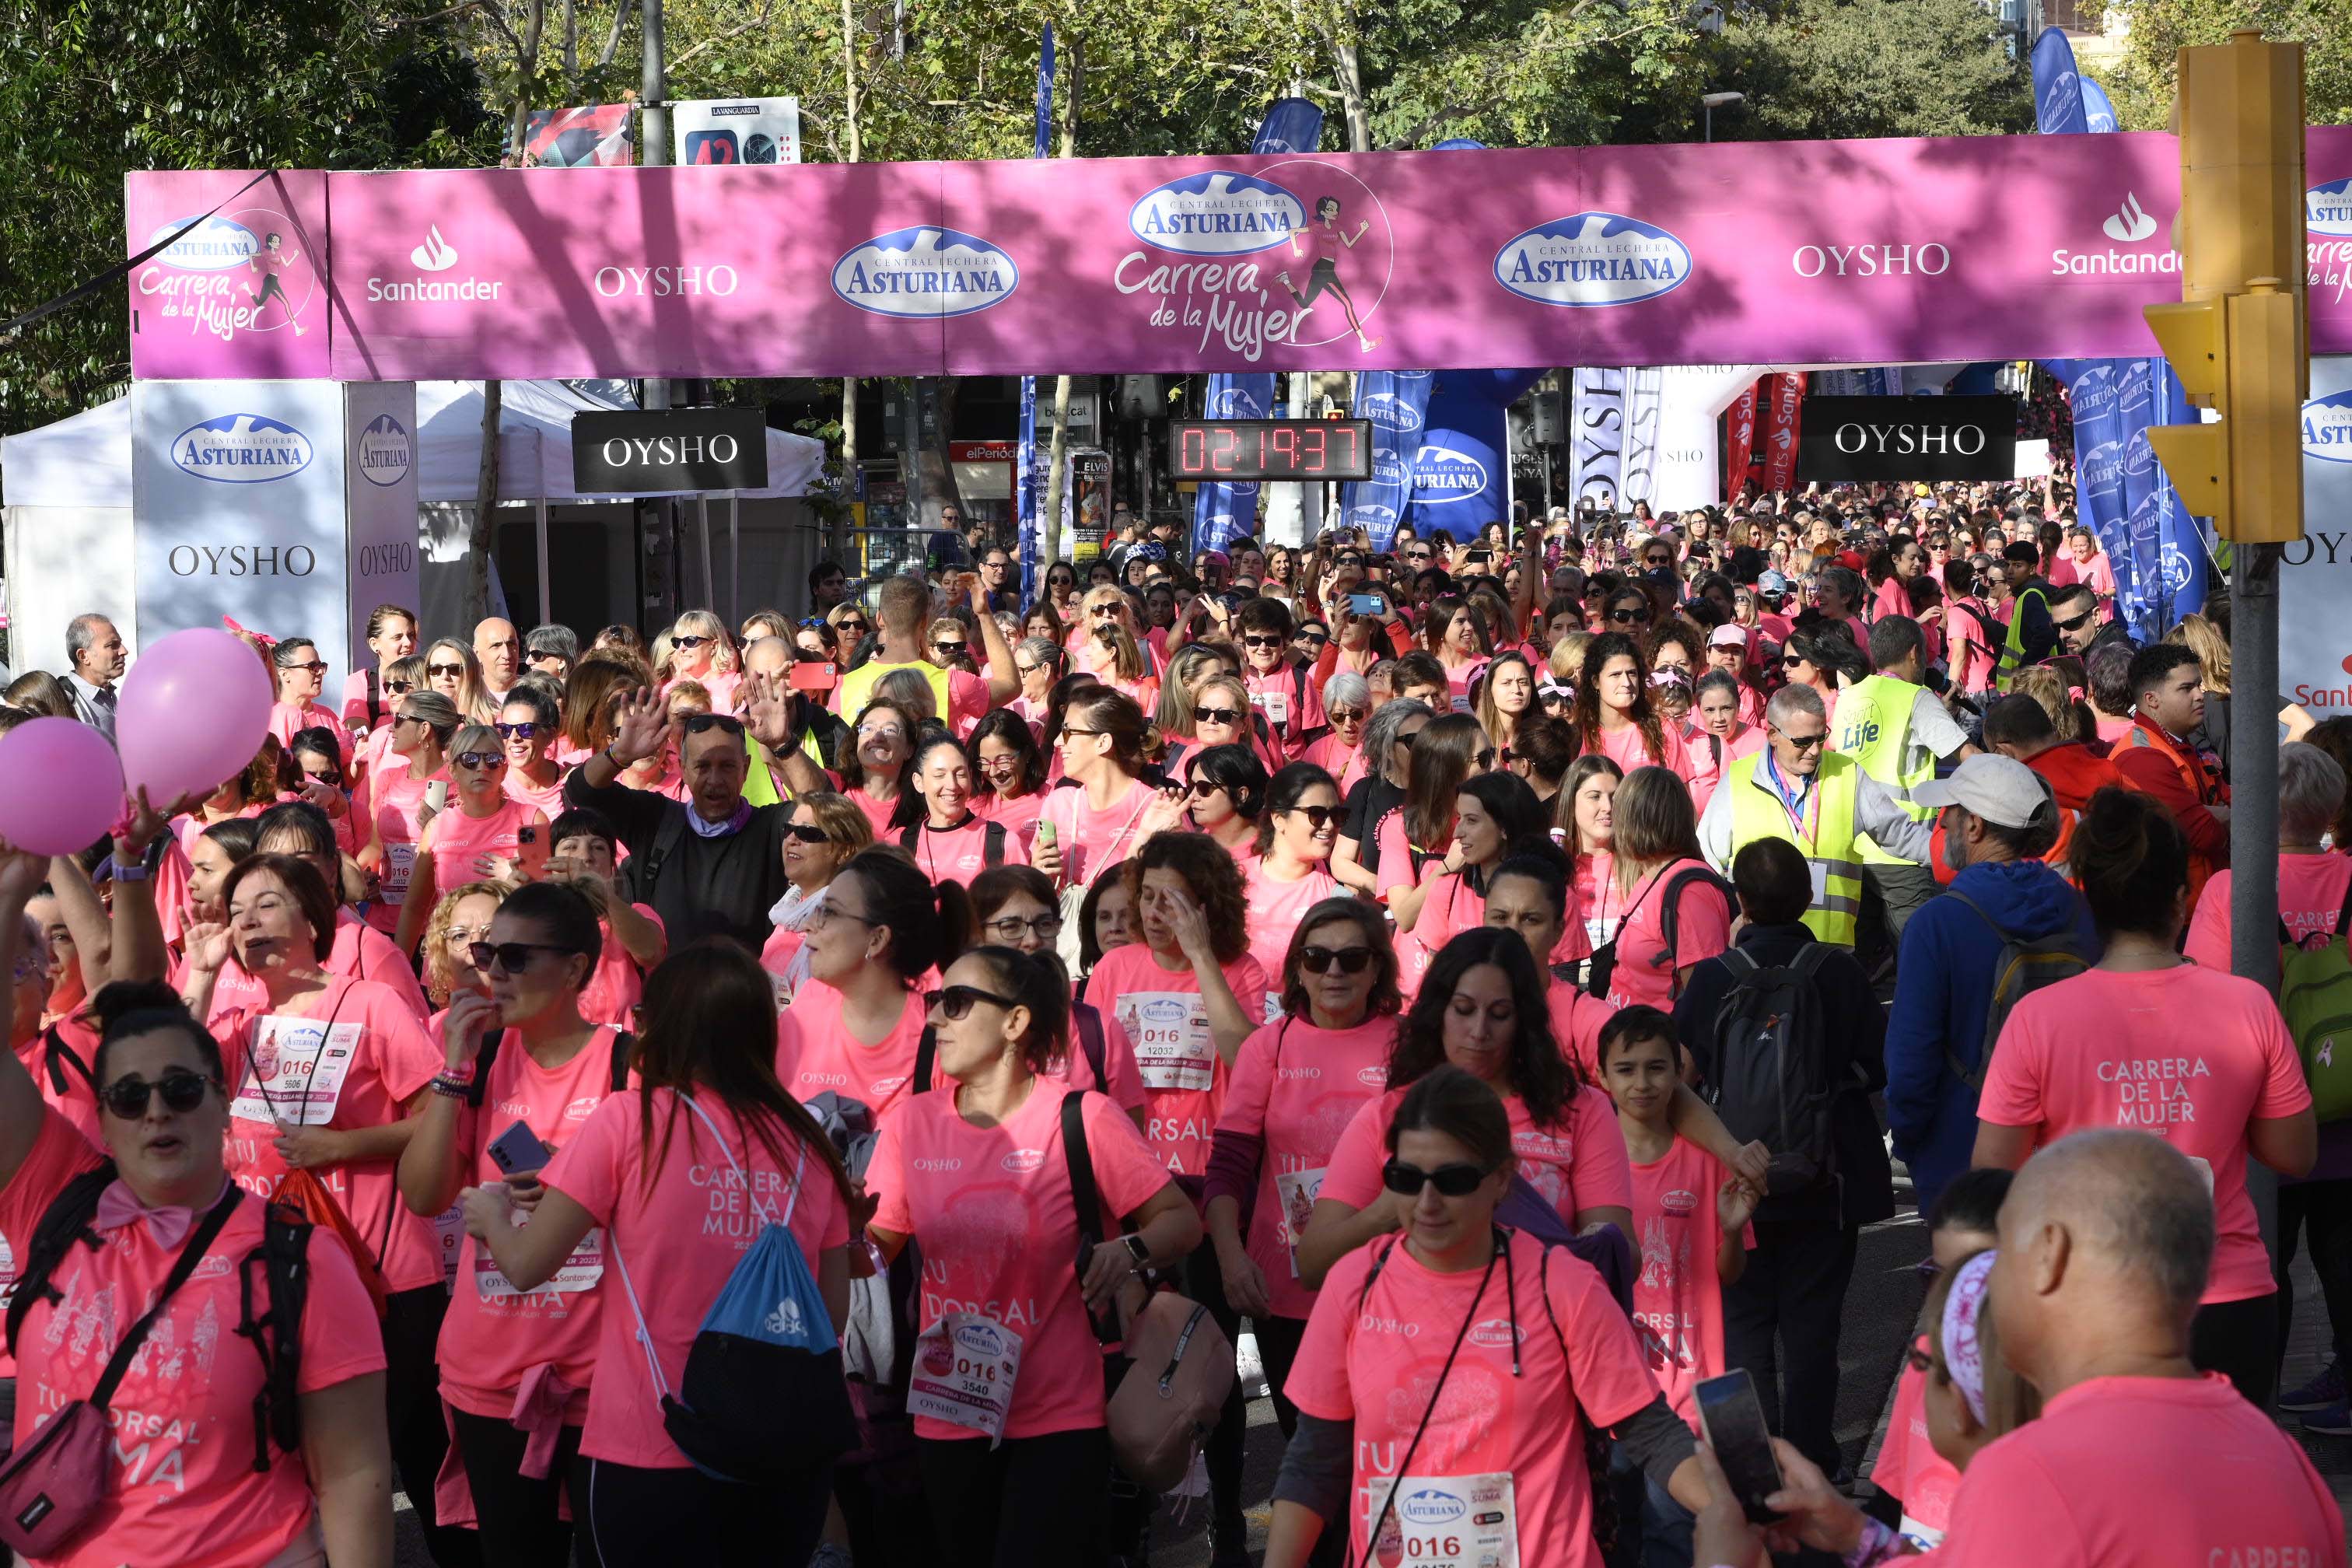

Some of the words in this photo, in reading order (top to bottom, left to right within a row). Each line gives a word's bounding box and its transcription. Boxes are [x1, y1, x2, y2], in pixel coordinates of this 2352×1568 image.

[1169, 200, 1227, 210] CENTRAL
[1230, 198, 1287, 208] LECHERA
[2306, 201, 2352, 222] ASTU
[1142, 203, 1291, 234] ASTURIANA
[1539, 245, 1601, 255] CENTRAL
[1607, 243, 1671, 254] LECHERA
[1792, 242, 1951, 278] OYSHO
[2307, 241, 2352, 264] arre
[874, 257, 935, 267] CENTRAL
[940, 257, 998, 266] LECHERA
[1114, 250, 1258, 296] Carrera
[1508, 248, 1677, 283] ASTURIANA
[2052, 249, 2182, 275] Santand
[138, 266, 230, 296] Carrera
[594, 264, 737, 297] OYSHO
[845, 261, 1005, 294] ASTURIANA
[2325, 263, 2338, 286] la
[367, 277, 502, 301] Santander
[161, 298, 178, 317] de
[182, 296, 194, 317] la
[192, 292, 266, 341] Mujer
[1150, 295, 1177, 327] de
[1182, 294, 1202, 327] la
[1198, 288, 1314, 362] Mujer
[1580, 367, 1622, 510] OYSH
[1626, 367, 1663, 506] OYSH
[1834, 422, 1986, 456] OYSHO
[182, 439, 303, 466] ASTURIANA
[362, 448, 408, 469] ASTURIANA
[602, 434, 738, 467] OYSHO
[967, 446, 1019, 459] elPeriódi
[1182, 429, 1356, 472] 02:19:37
[1084, 462, 1108, 471] ELVIS
[1412, 474, 1479, 488] TURIANA
[359, 541, 412, 577] OYSHO
[2280, 532, 2352, 565] OY
[168, 544, 316, 577] OYSHO
[1842, 720, 1879, 753] Life
[285, 1036, 323, 1048] ASTURIAN
[1144, 1029, 1179, 1042] 016
[1147, 1047, 1174, 1055] 12032
[282, 1060, 313, 1075] 016
[801, 1072, 847, 1086] OYSHO
[1278, 1066, 1321, 1080] OYSHO
[2097, 1055, 2210, 1082] CARRERA
[2120, 1081, 2150, 1103] DE
[2159, 1080, 2189, 1101] LA
[492, 1099, 531, 1116] YSHO
[2116, 1101, 2196, 1125] MUJER
[1148, 1117, 1212, 1142] RSAL
[233, 1139, 256, 1161] TU
[1511, 1143, 1570, 1159] STURIANA
[914, 1157, 962, 1171] OYSHO
[709, 1190, 740, 1213] DE
[1663, 1195, 1696, 1206] ASTURIANA
[702, 1213, 782, 1237] MUJ
[485, 1277, 510, 1288] OYS
[559, 1273, 597, 1283] Santander
[1643, 1332, 1694, 1363] MA
[957, 1358, 996, 1382] 016
[37, 1382, 66, 1411] TU
[962, 1380, 989, 1395] 3540
[919, 1398, 958, 1416] OYSHO
[109, 1407, 201, 1444] ORSAL
[109, 1436, 185, 1492] MA
[1405, 1503, 1461, 1516] ASTURIANA
[1472, 1493, 1501, 1503] SUMA
[1407, 1536, 1461, 1557] 016
